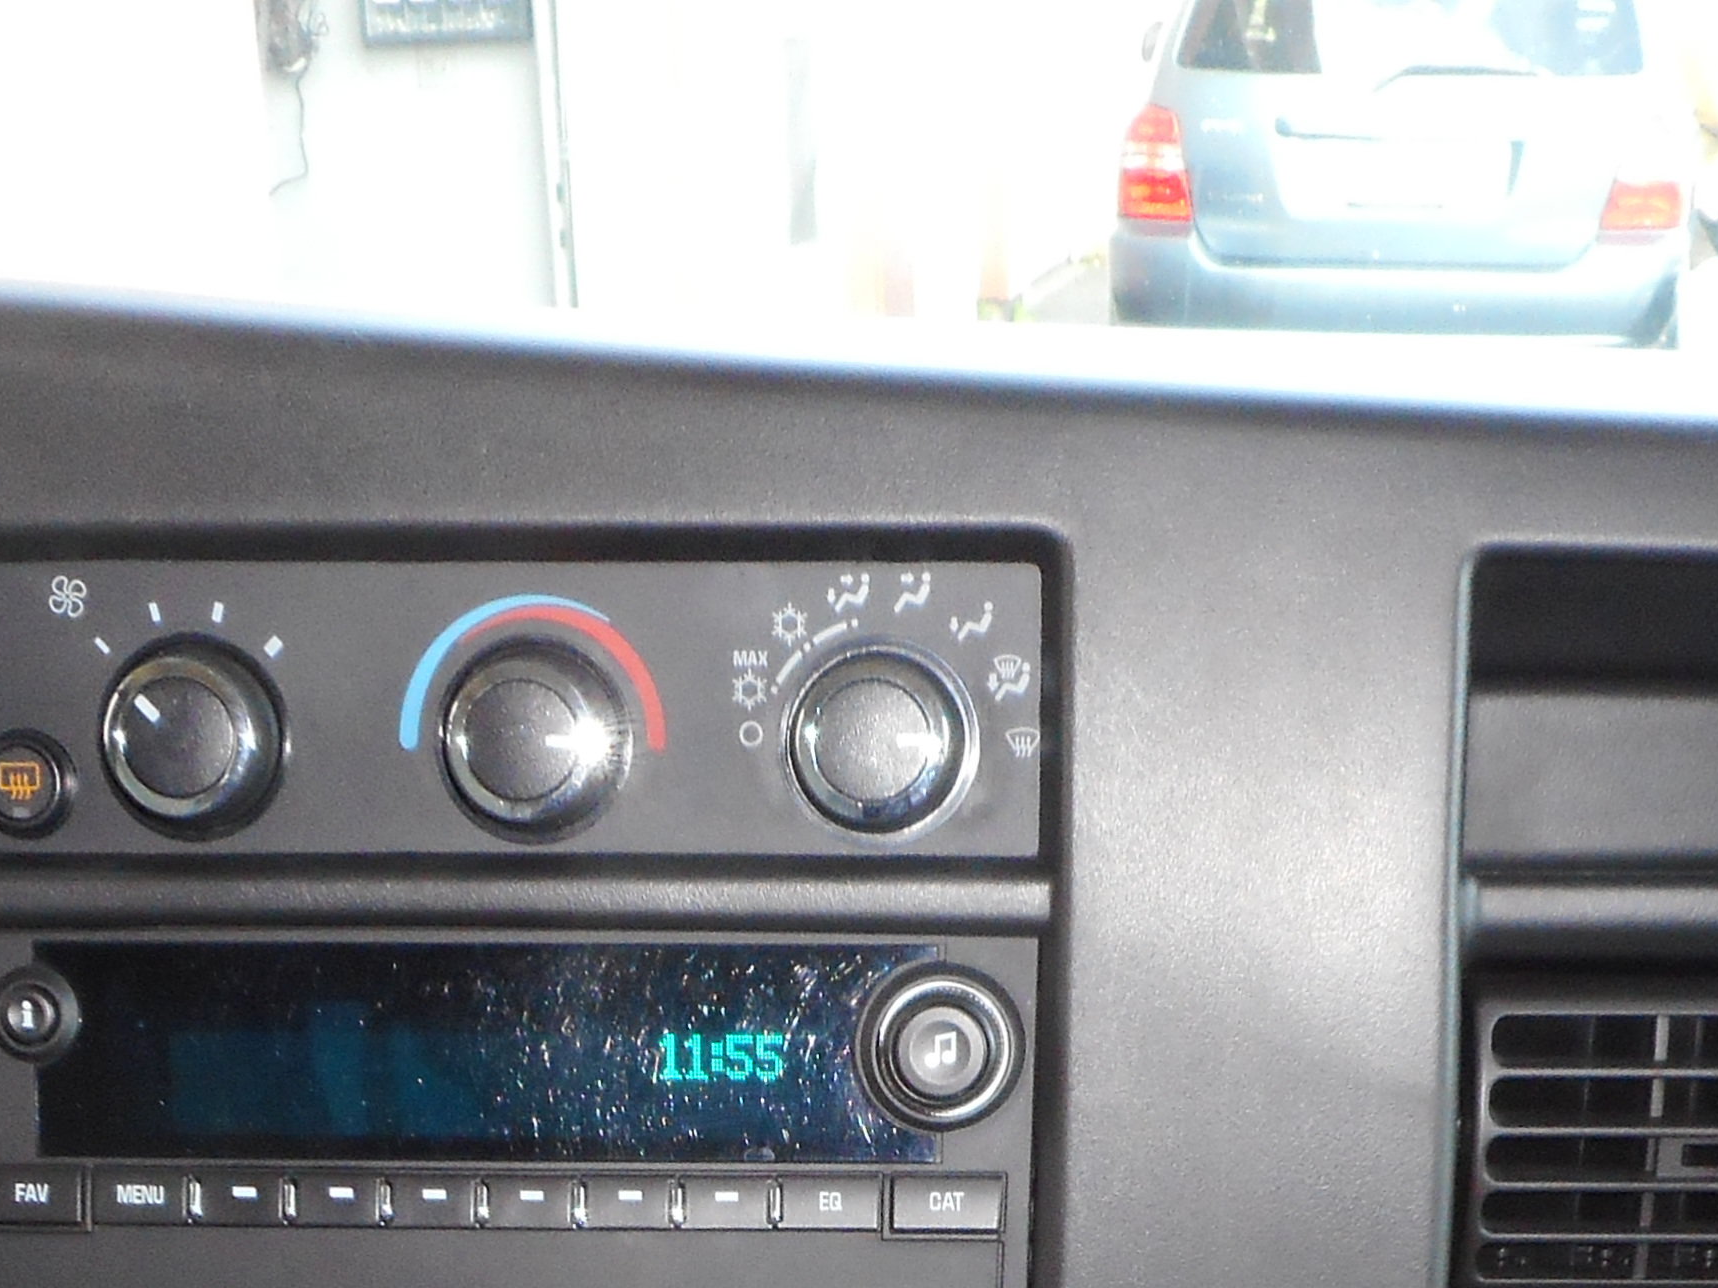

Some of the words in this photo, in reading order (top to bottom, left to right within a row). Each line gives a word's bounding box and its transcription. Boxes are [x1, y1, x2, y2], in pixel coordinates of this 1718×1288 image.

[733, 649, 768, 667] MAX
[658, 1032, 787, 1081] 11:55
[14, 1183, 49, 1203] FAV
[116, 1184, 165, 1205] MENU
[818, 1191, 843, 1213] EQ
[929, 1191, 965, 1213] CAT
